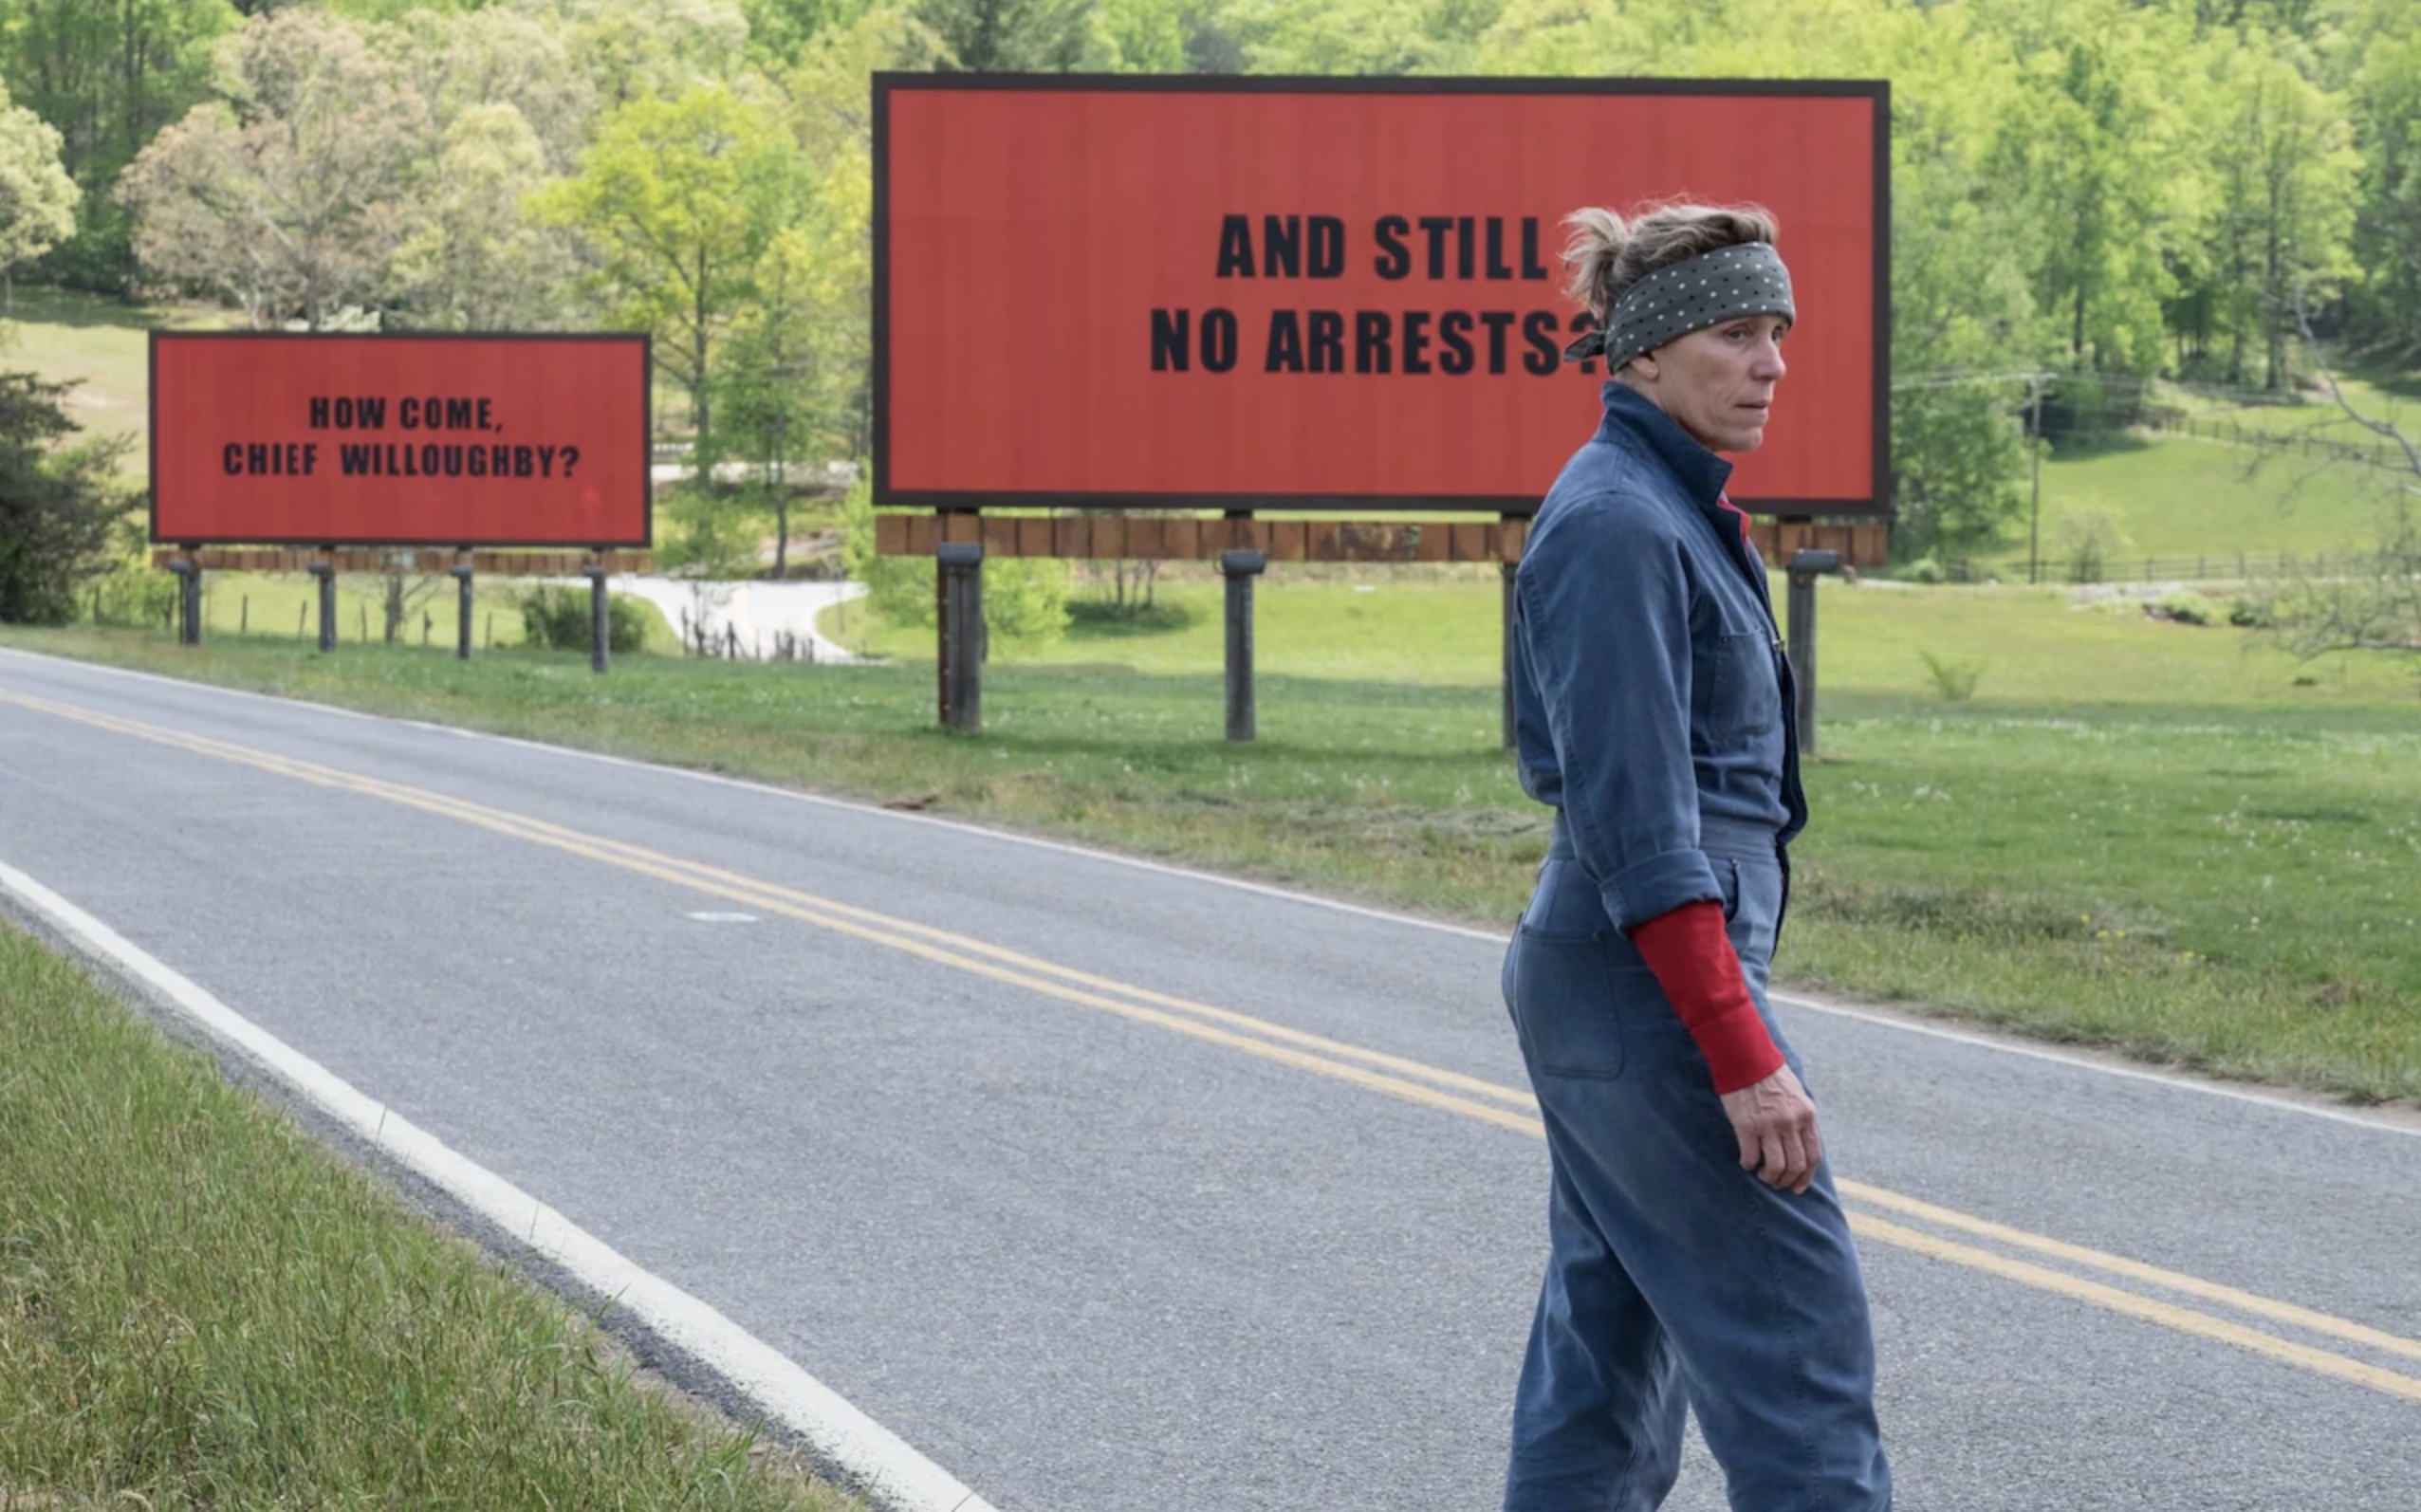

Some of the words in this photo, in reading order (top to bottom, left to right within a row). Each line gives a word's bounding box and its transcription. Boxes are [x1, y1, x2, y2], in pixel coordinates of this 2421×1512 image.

[1215, 213, 1345, 280] AND
[1374, 215, 1548, 281] STILL
[1151, 307, 1238, 374] NO
[309, 396, 386, 430] HOW
[399, 396, 503, 433] COME,
[223, 442, 317, 476] CHIEF
[340, 444, 581, 478] WILLOUGHBY?
